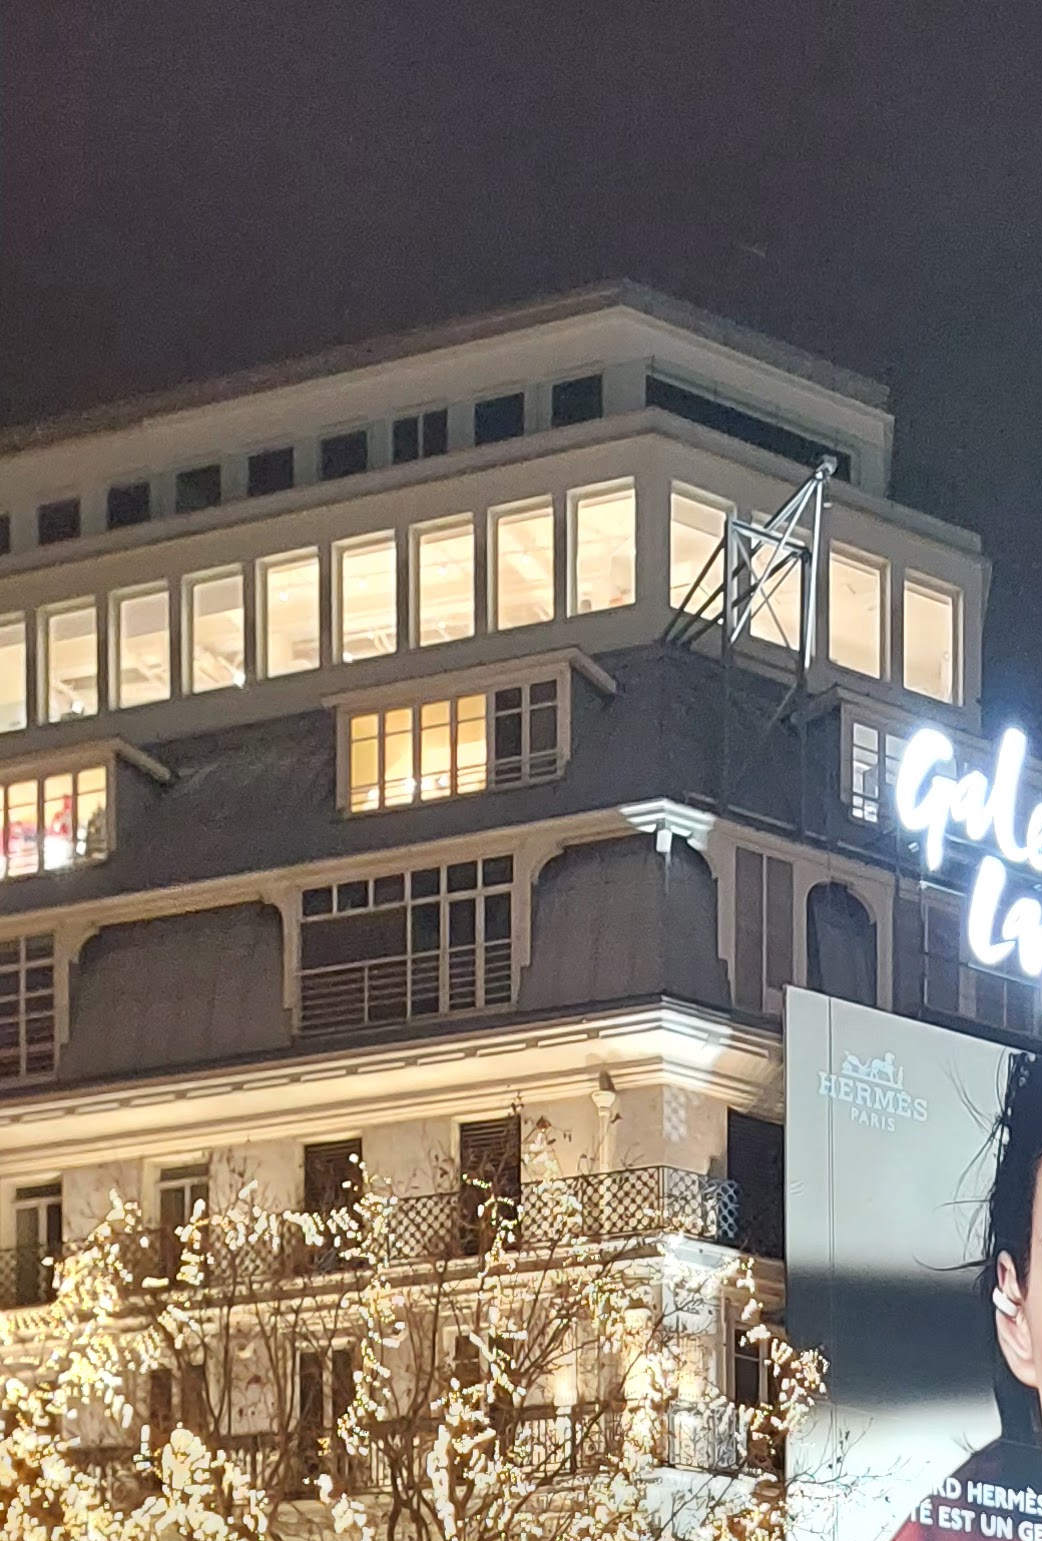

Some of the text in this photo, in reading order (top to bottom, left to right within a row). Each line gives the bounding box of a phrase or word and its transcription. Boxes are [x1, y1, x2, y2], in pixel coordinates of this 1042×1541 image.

[851, 1107, 895, 1132] PARIS
[938, 1505, 976, 1533] EST
[980, 1511, 1013, 1540] UN
